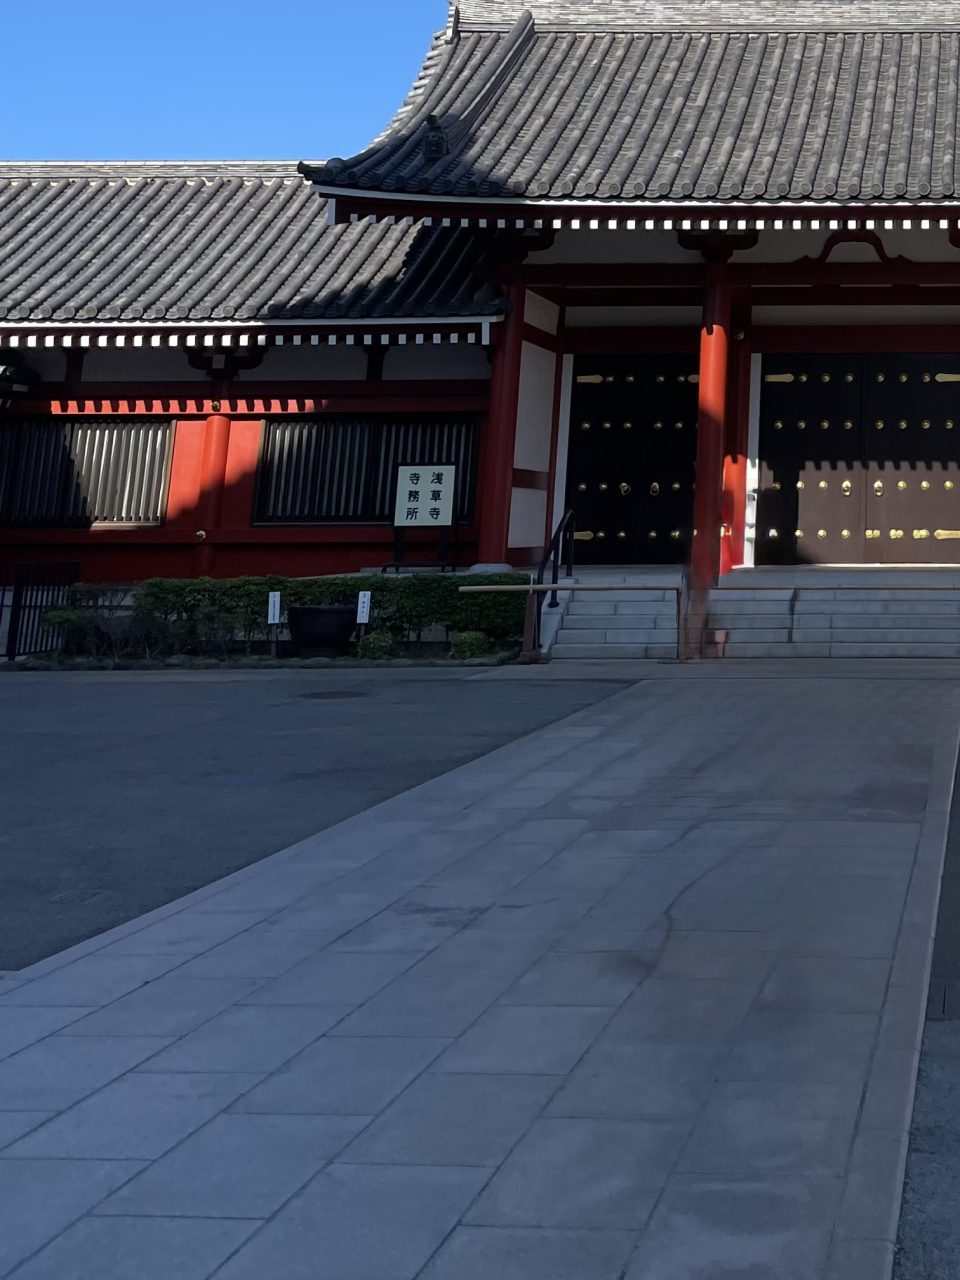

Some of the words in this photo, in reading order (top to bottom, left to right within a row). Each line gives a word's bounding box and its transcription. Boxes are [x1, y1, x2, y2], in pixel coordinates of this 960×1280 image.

[406, 473, 421, 520] 寺務所
[429, 472, 444, 520] 浅草寺
